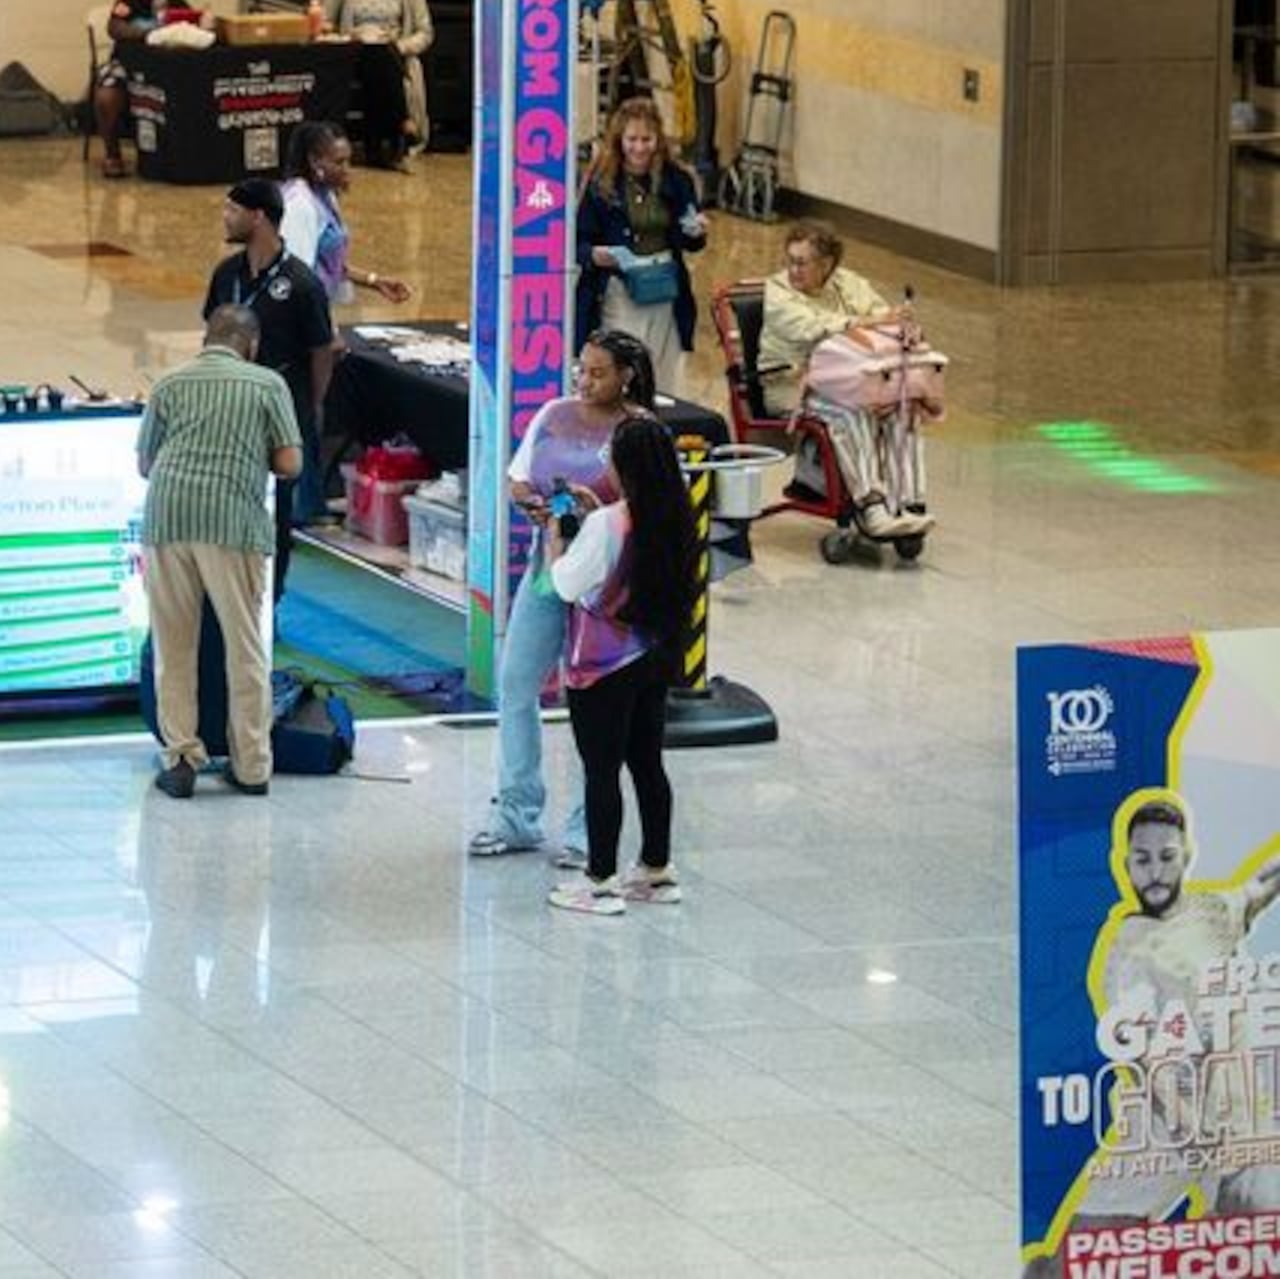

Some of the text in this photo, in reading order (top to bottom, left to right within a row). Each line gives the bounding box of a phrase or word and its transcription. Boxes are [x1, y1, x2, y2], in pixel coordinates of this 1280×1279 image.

[512, 109, 568, 375] GATES
[1046, 689, 1108, 734] 100
[1037, 1073, 1090, 1127] TO
[1088, 1160, 1126, 1181] AN
[1139, 1155, 1177, 1177] ATL
[1068, 1215, 1280, 1260] PASSENGE
